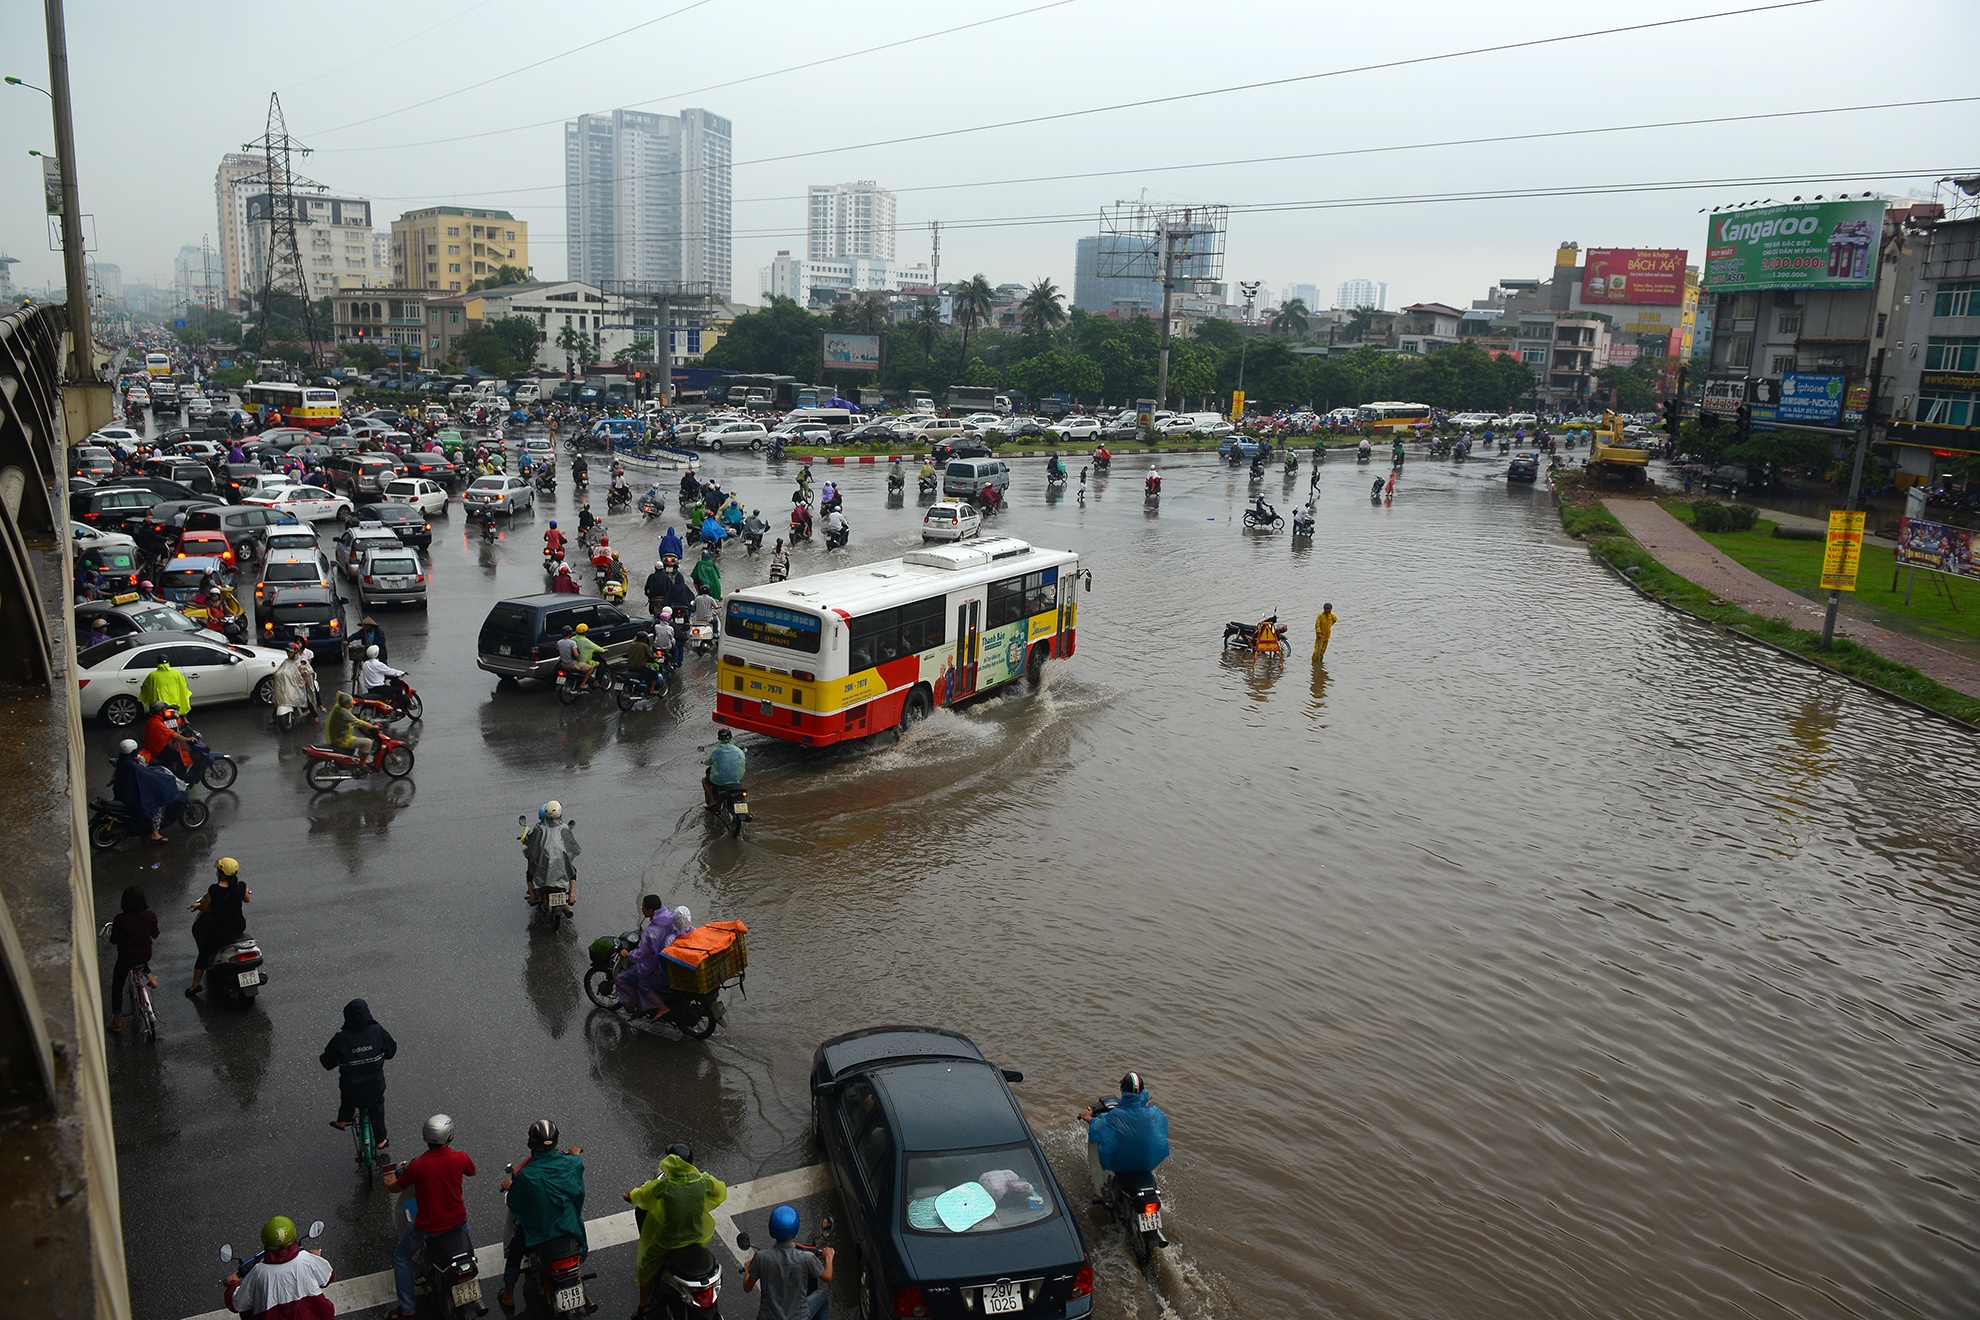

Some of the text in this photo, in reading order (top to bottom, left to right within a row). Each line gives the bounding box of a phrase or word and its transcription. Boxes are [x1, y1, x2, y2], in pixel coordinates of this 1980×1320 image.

[1789, 204, 1803, 212] Việt
[1714, 217, 1819, 245] Kangaroo
[1628, 258, 1656, 270] BÁCH
[1727, 272, 1747, 282] ASEN
[1798, 382, 1824, 393] iphone
[732, 604, 739, 612] 26
[982, 634, 996, 646] Thanh
[750, 680, 762, 690] 29N
[768, 684, 782, 694] 7978
[844, 683, 854, 692] 29N
[857, 678, 868, 688] 7978
[352, 1045, 372, 1054] adidas
[1142, 1220, 1160, 1230] 1492
[560, 1287, 580, 1300] 19-K8
[991, 1284, 1012, 1299] 29V
[562, 1296, 580, 1310] 4177
[990, 1297, 1017, 1312] 1025
